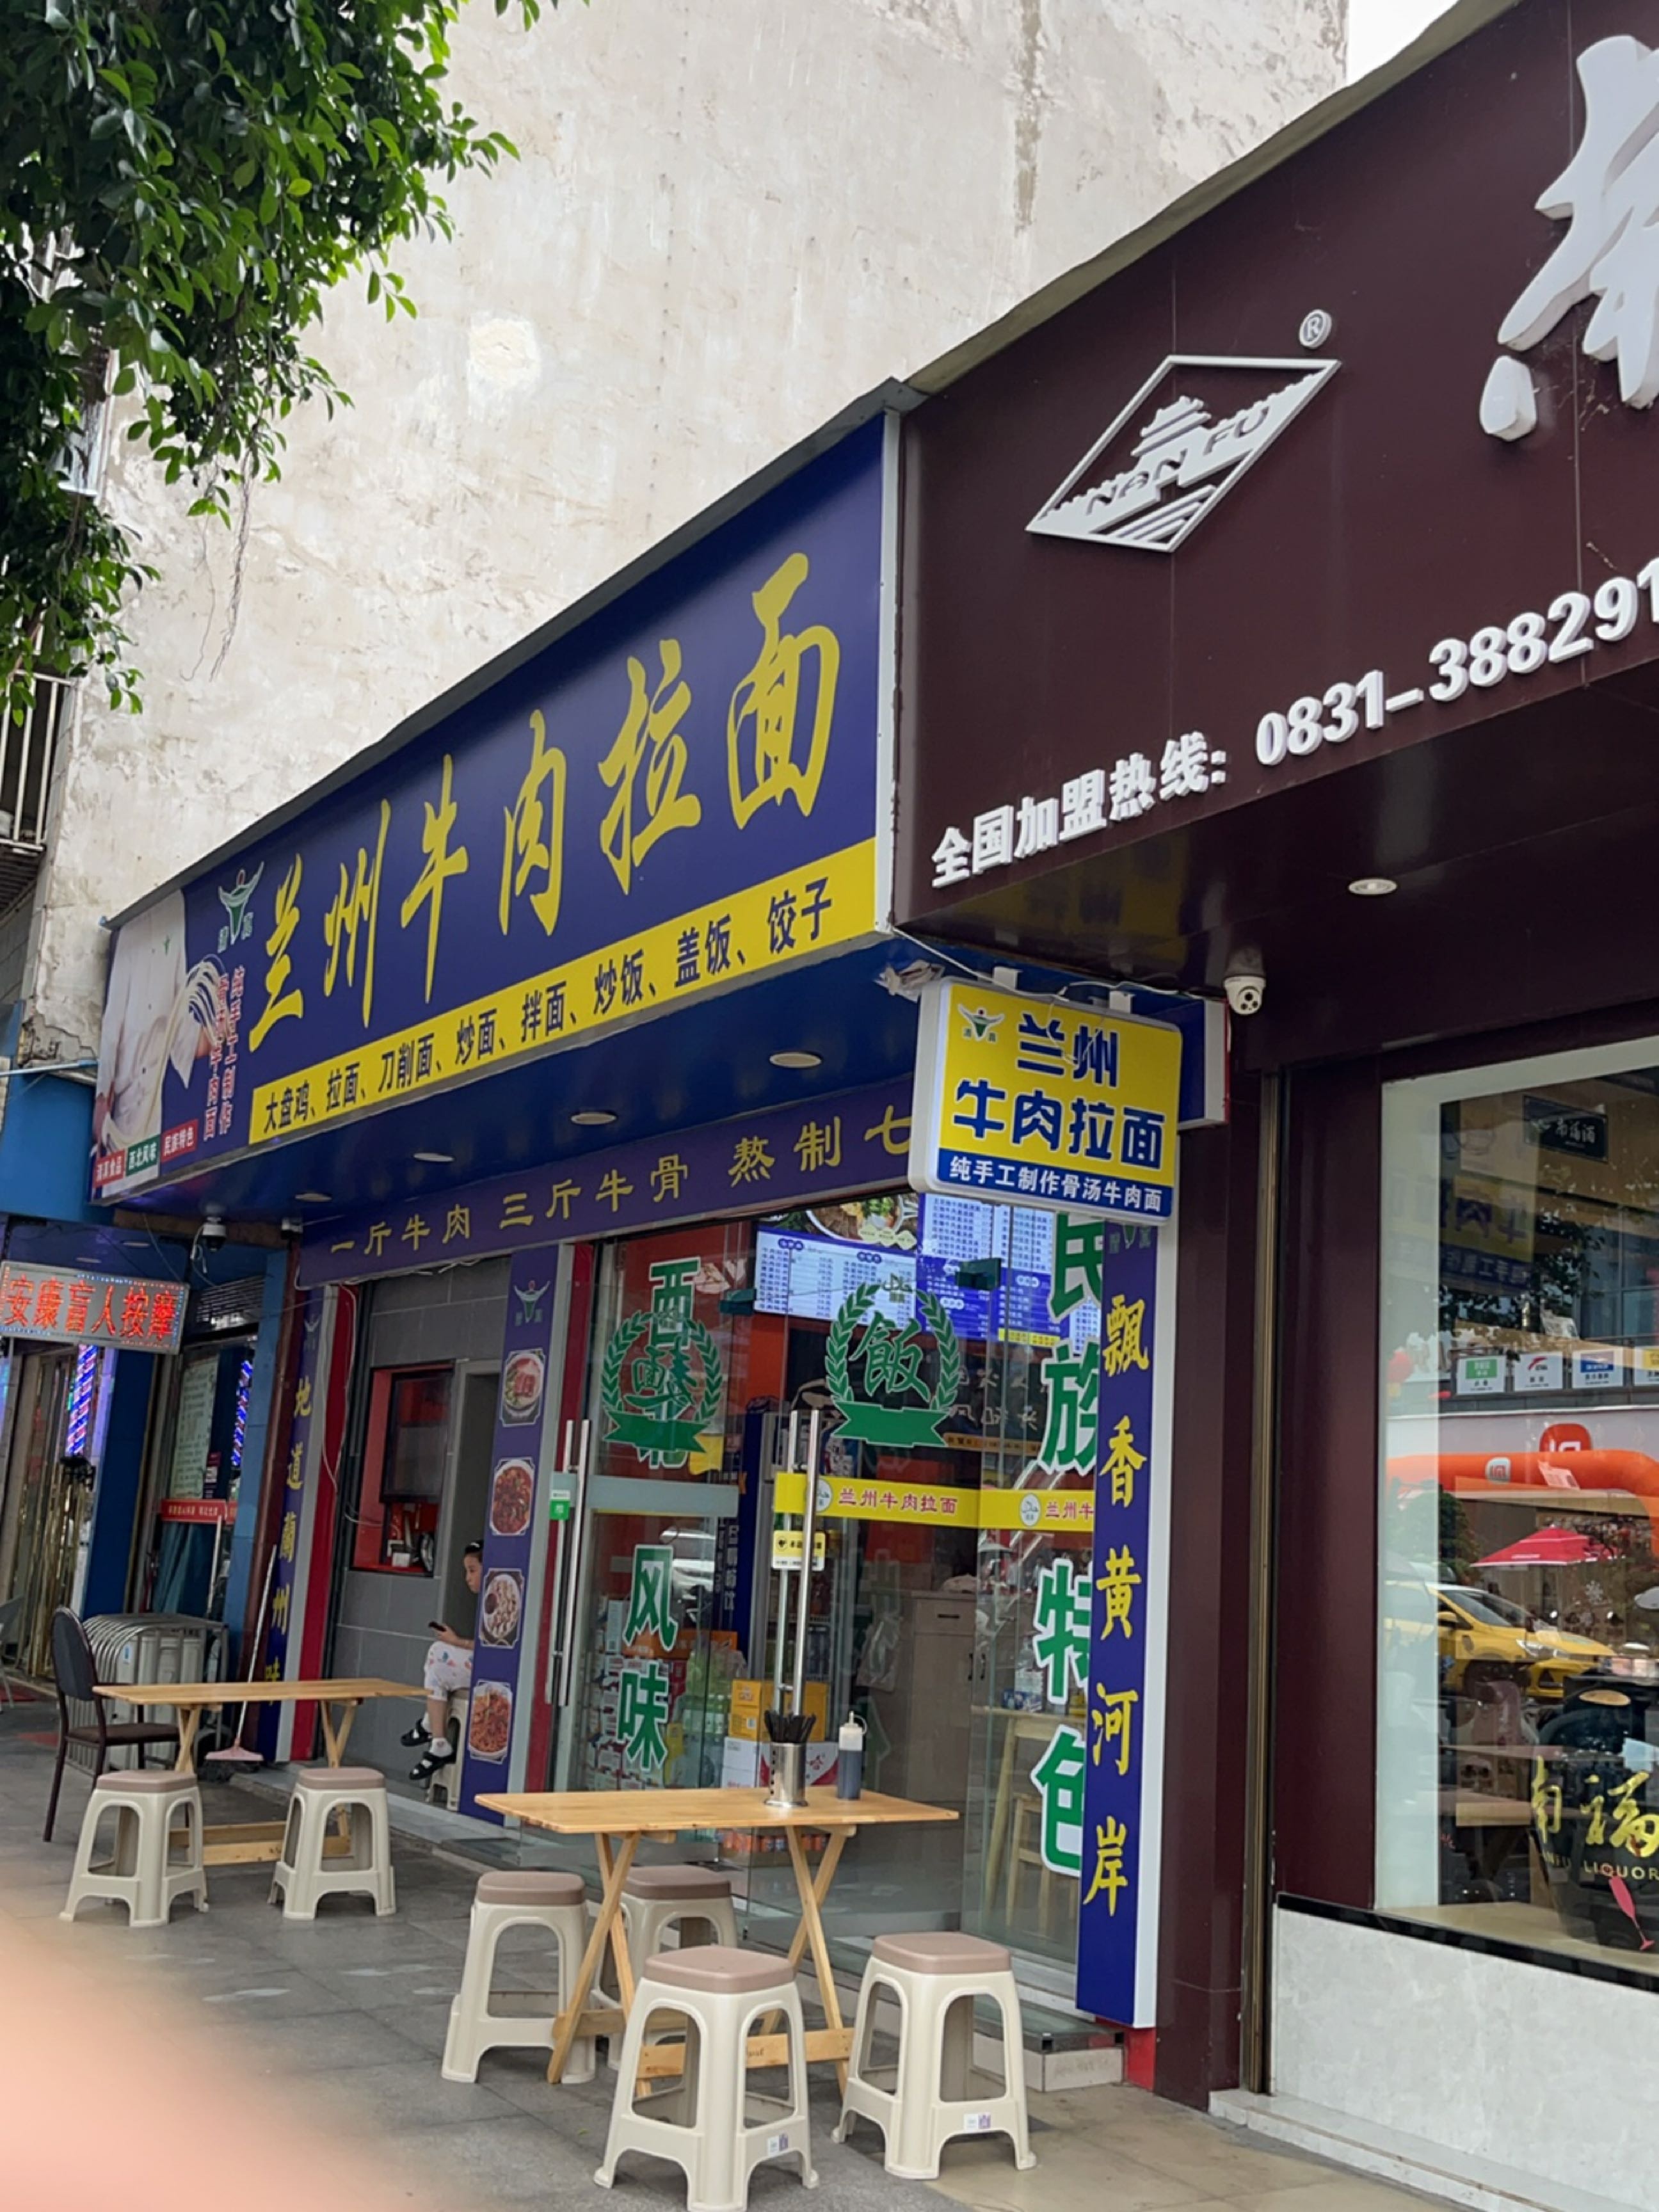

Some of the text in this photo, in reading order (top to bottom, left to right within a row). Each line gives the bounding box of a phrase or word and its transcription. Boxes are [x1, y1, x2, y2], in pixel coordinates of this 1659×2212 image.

[248, 552, 840, 1053] 兰州牛肉拉面
[1016, 1013, 1119, 1087] 兰州
[952, 1078, 1166, 1173] 牛肉拉面
[330, 1203, 471, 1258] 一斤牛肉
[499, 1153, 689, 1229] 三斤牛骨
[949, 1154, 1163, 1212] 纯手工制作骨汤牛肉面
[3, 1274, 178, 1342] 安康盲人按摩
[838, 1488, 958, 1514] 兰州牛肉拉面
[1045, 1501, 1094, 1521] 兰州牛
